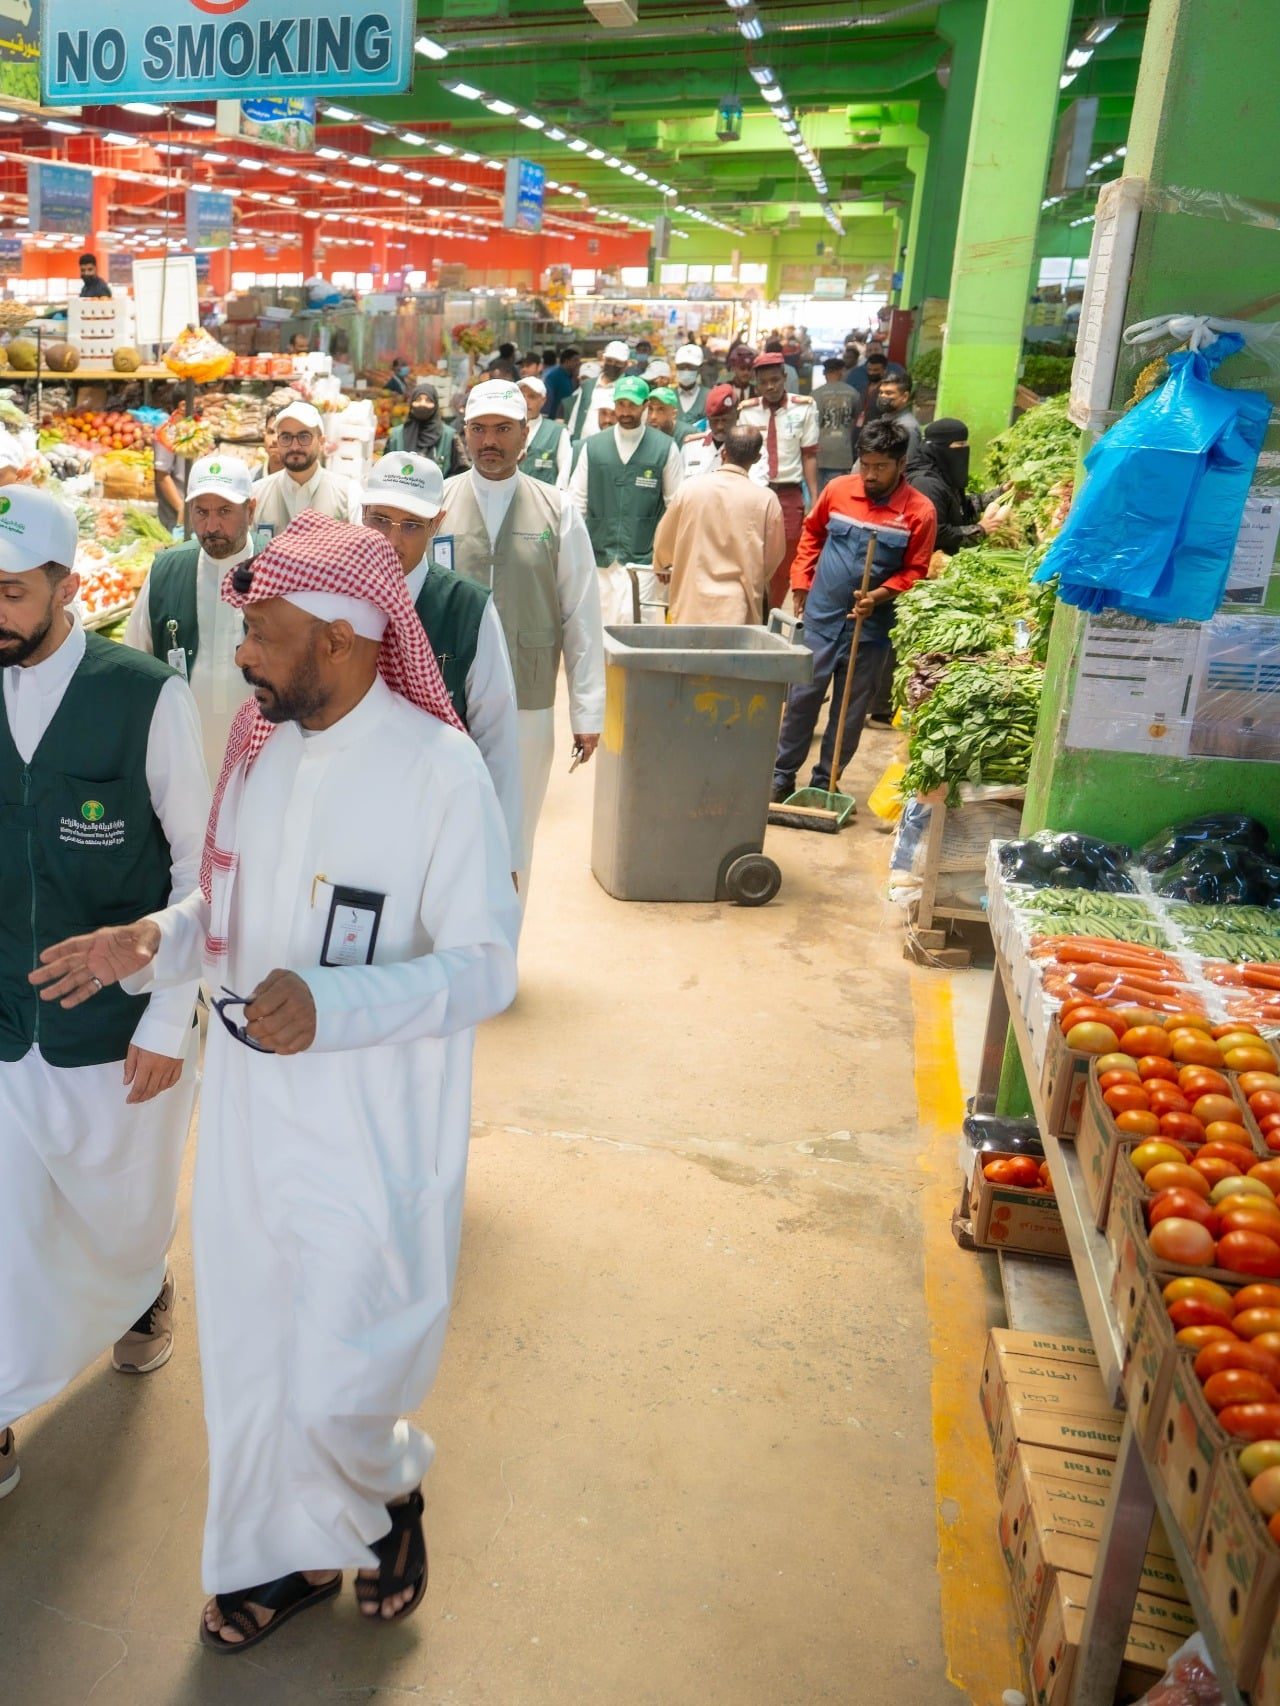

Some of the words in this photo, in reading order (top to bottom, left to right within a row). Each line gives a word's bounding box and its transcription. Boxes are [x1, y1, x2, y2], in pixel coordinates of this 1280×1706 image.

[56, 28, 126, 84] NO
[143, 14, 392, 81] SMOKING
[1047, 1489, 1105, 1507] لطائف
